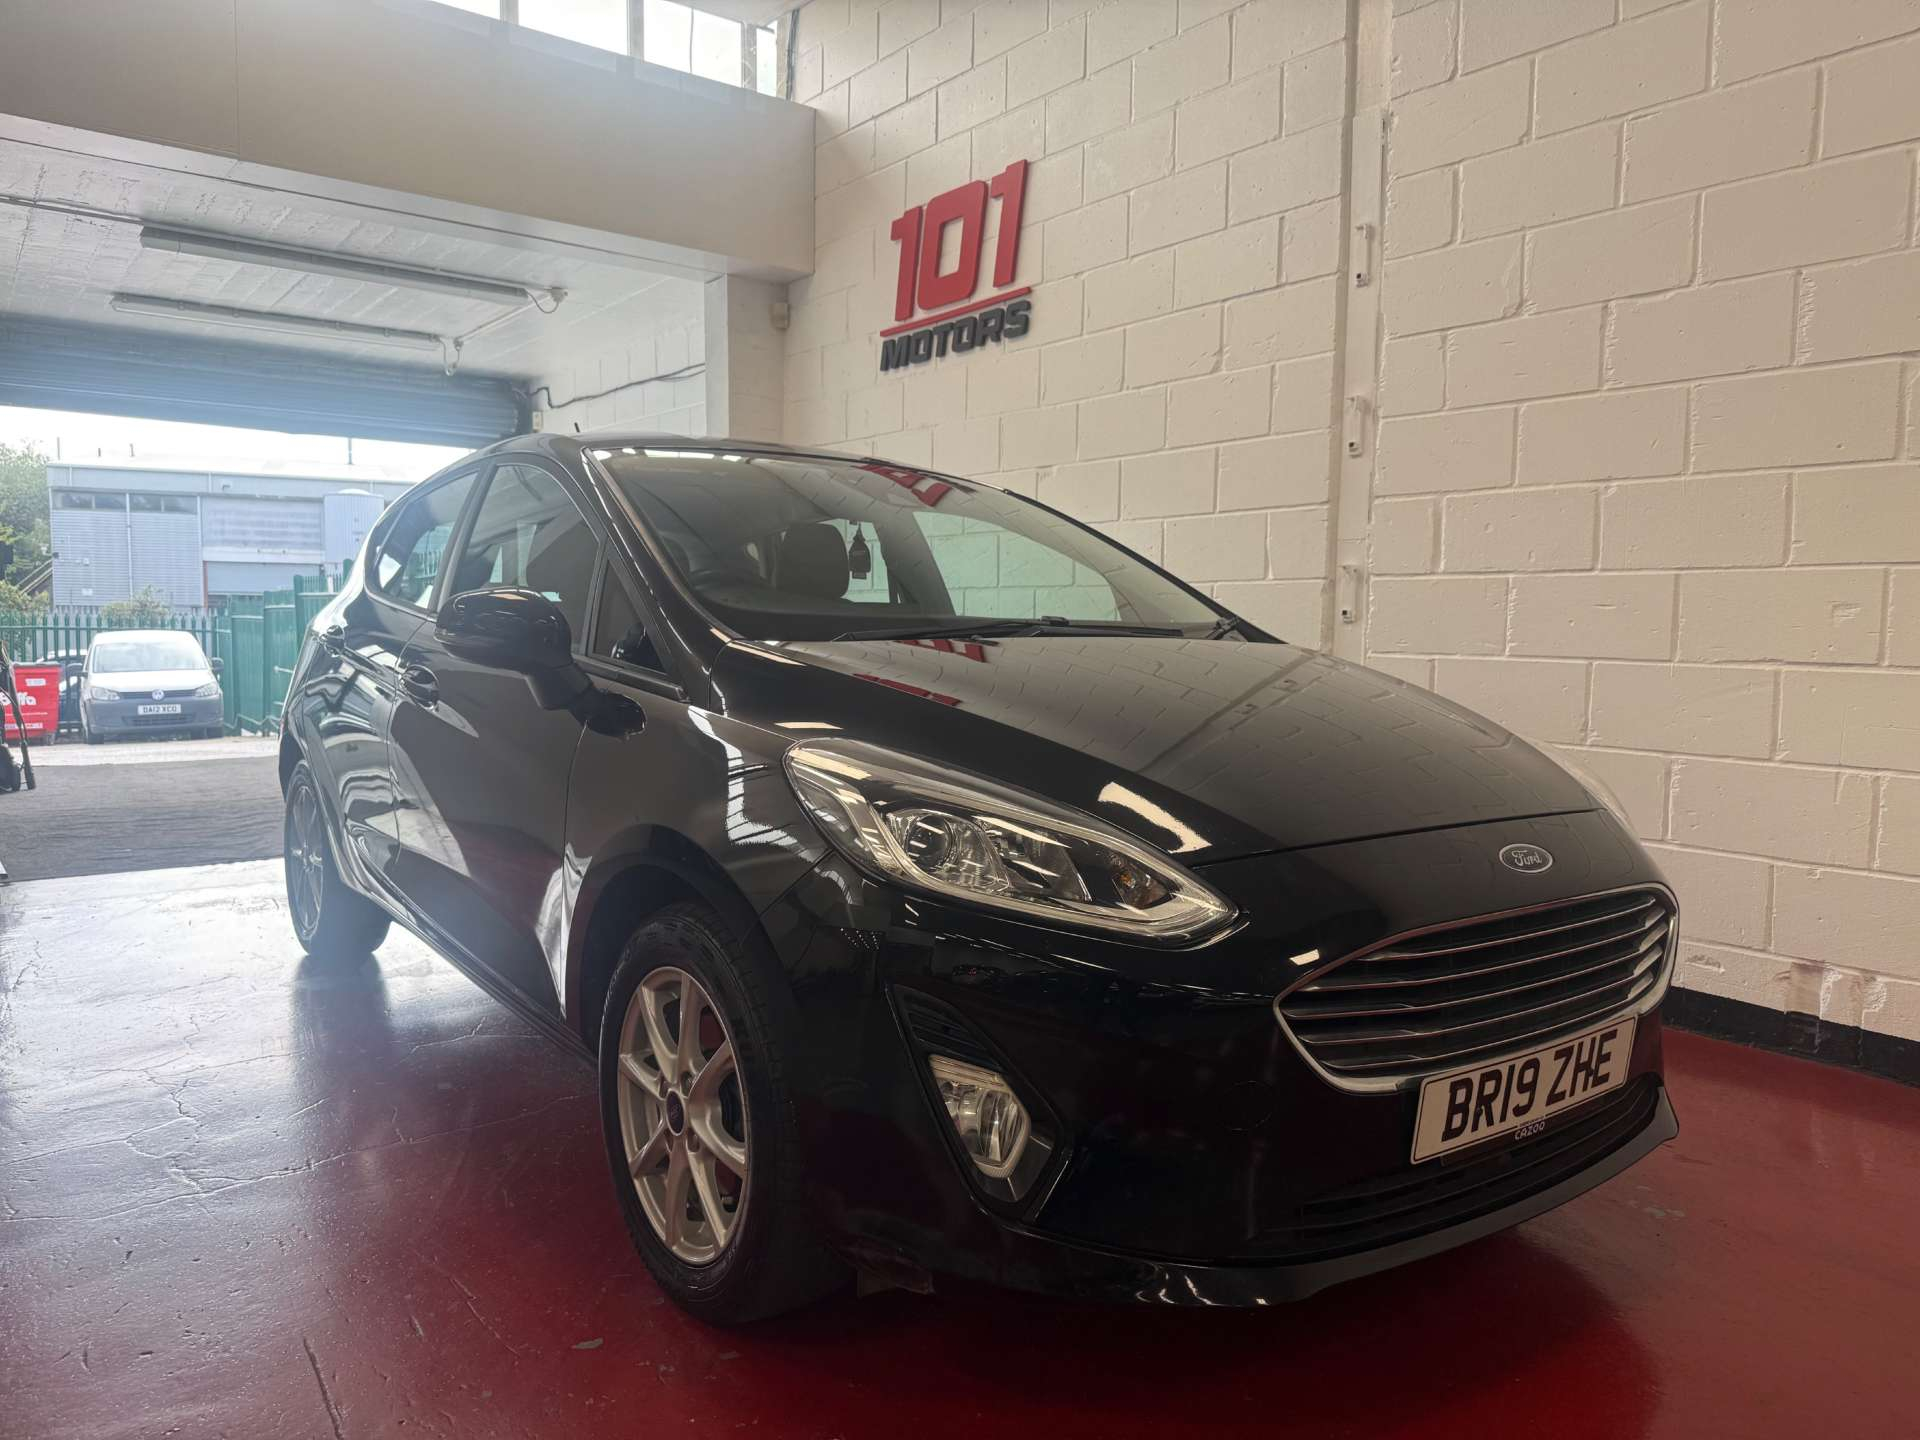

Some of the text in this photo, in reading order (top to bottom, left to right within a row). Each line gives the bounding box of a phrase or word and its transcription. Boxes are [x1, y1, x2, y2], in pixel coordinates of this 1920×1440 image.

[891, 159, 1028, 322] 101
[880, 299, 1032, 372] MOTORS
[1511, 850, 1543, 867] Ford
[1441, 1028, 1618, 1143] BR19 ZHE
[1514, 1121, 1546, 1141] CAZOO
